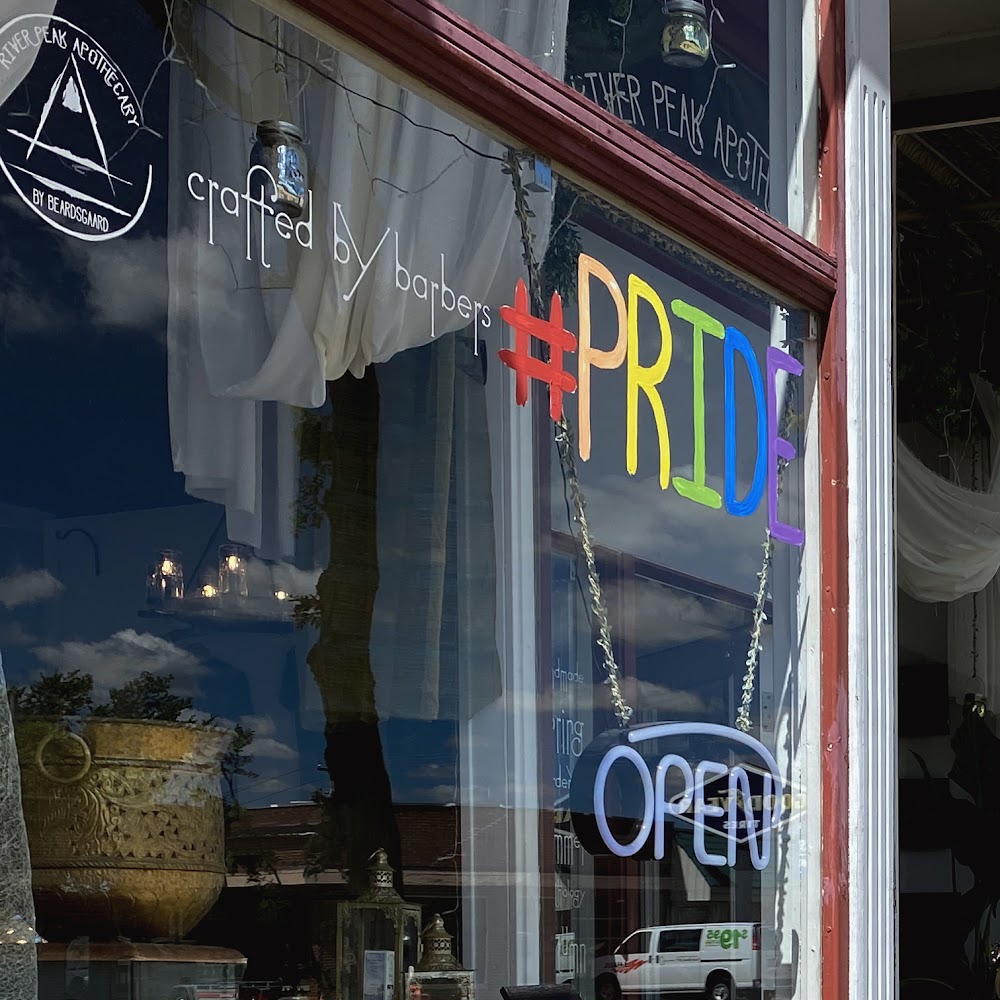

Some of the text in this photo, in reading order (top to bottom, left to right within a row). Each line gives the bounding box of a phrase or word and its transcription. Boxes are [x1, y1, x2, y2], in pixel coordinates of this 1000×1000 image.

[0, 26, 140, 128] RIVER PEAK APOTHECARY
[570, 71, 645, 127] IVER
[651, 80, 704, 156] PEAK
[33, 188, 110, 233] BY BEARDSGAARD
[188, 165, 491, 356] crafted by barbers
[498, 252, 804, 546] #PRIDE
[593, 744, 771, 871] OPEN
